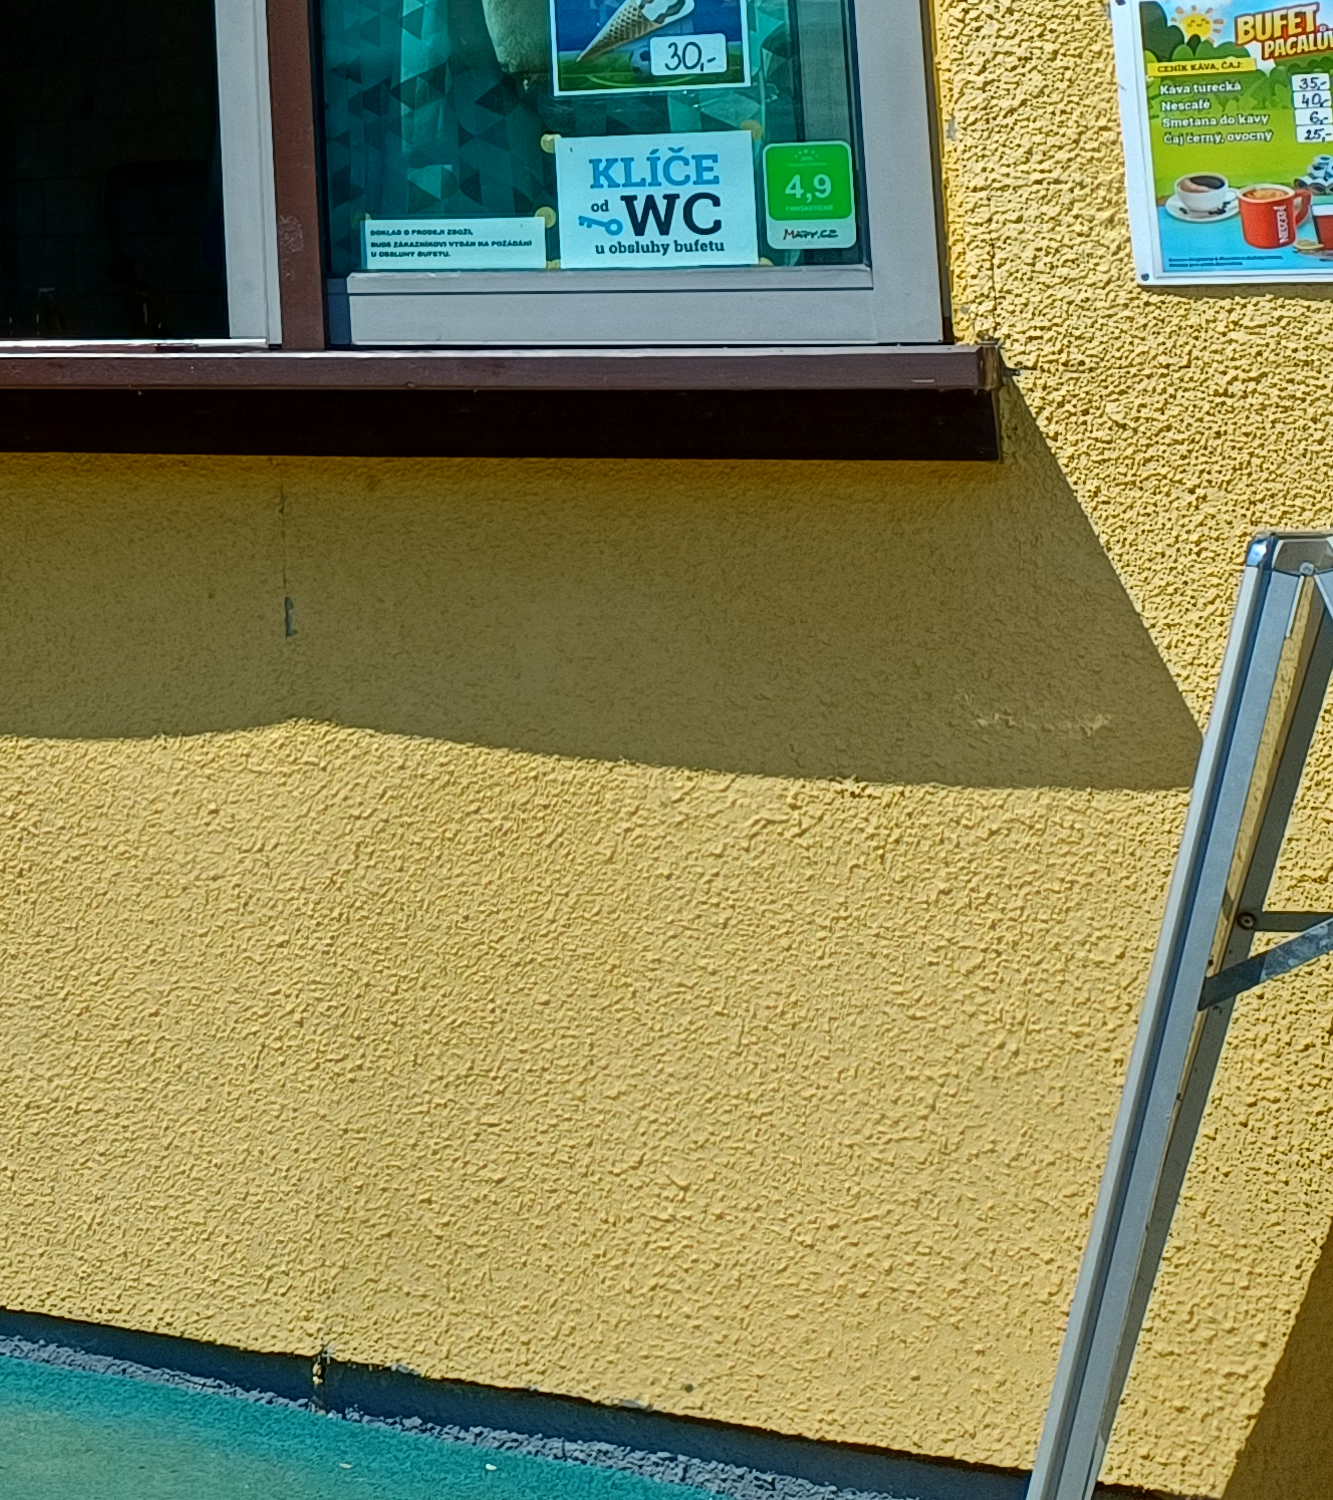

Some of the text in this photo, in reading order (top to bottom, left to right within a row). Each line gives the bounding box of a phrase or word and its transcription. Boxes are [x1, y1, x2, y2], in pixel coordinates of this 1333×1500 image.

[1236, 3, 1319, 45] BUFET
[664, 40, 718, 73] 30,-
[1160, 81, 1241, 95] Káva turecká
[1161, 101, 1211, 112] Nescafé
[1162, 114, 1269, 128] Smetana do kávy
[1164, 133, 1184, 145] Čaj
[1227, 130, 1273, 141] ovocný
[589, 148, 720, 190] KLÍČE
[785, 174, 832, 203] 4,9
[591, 199, 610, 214] od
[620, 193, 723, 237] WC
[595, 237, 725, 258] u obsluhy bufetu
